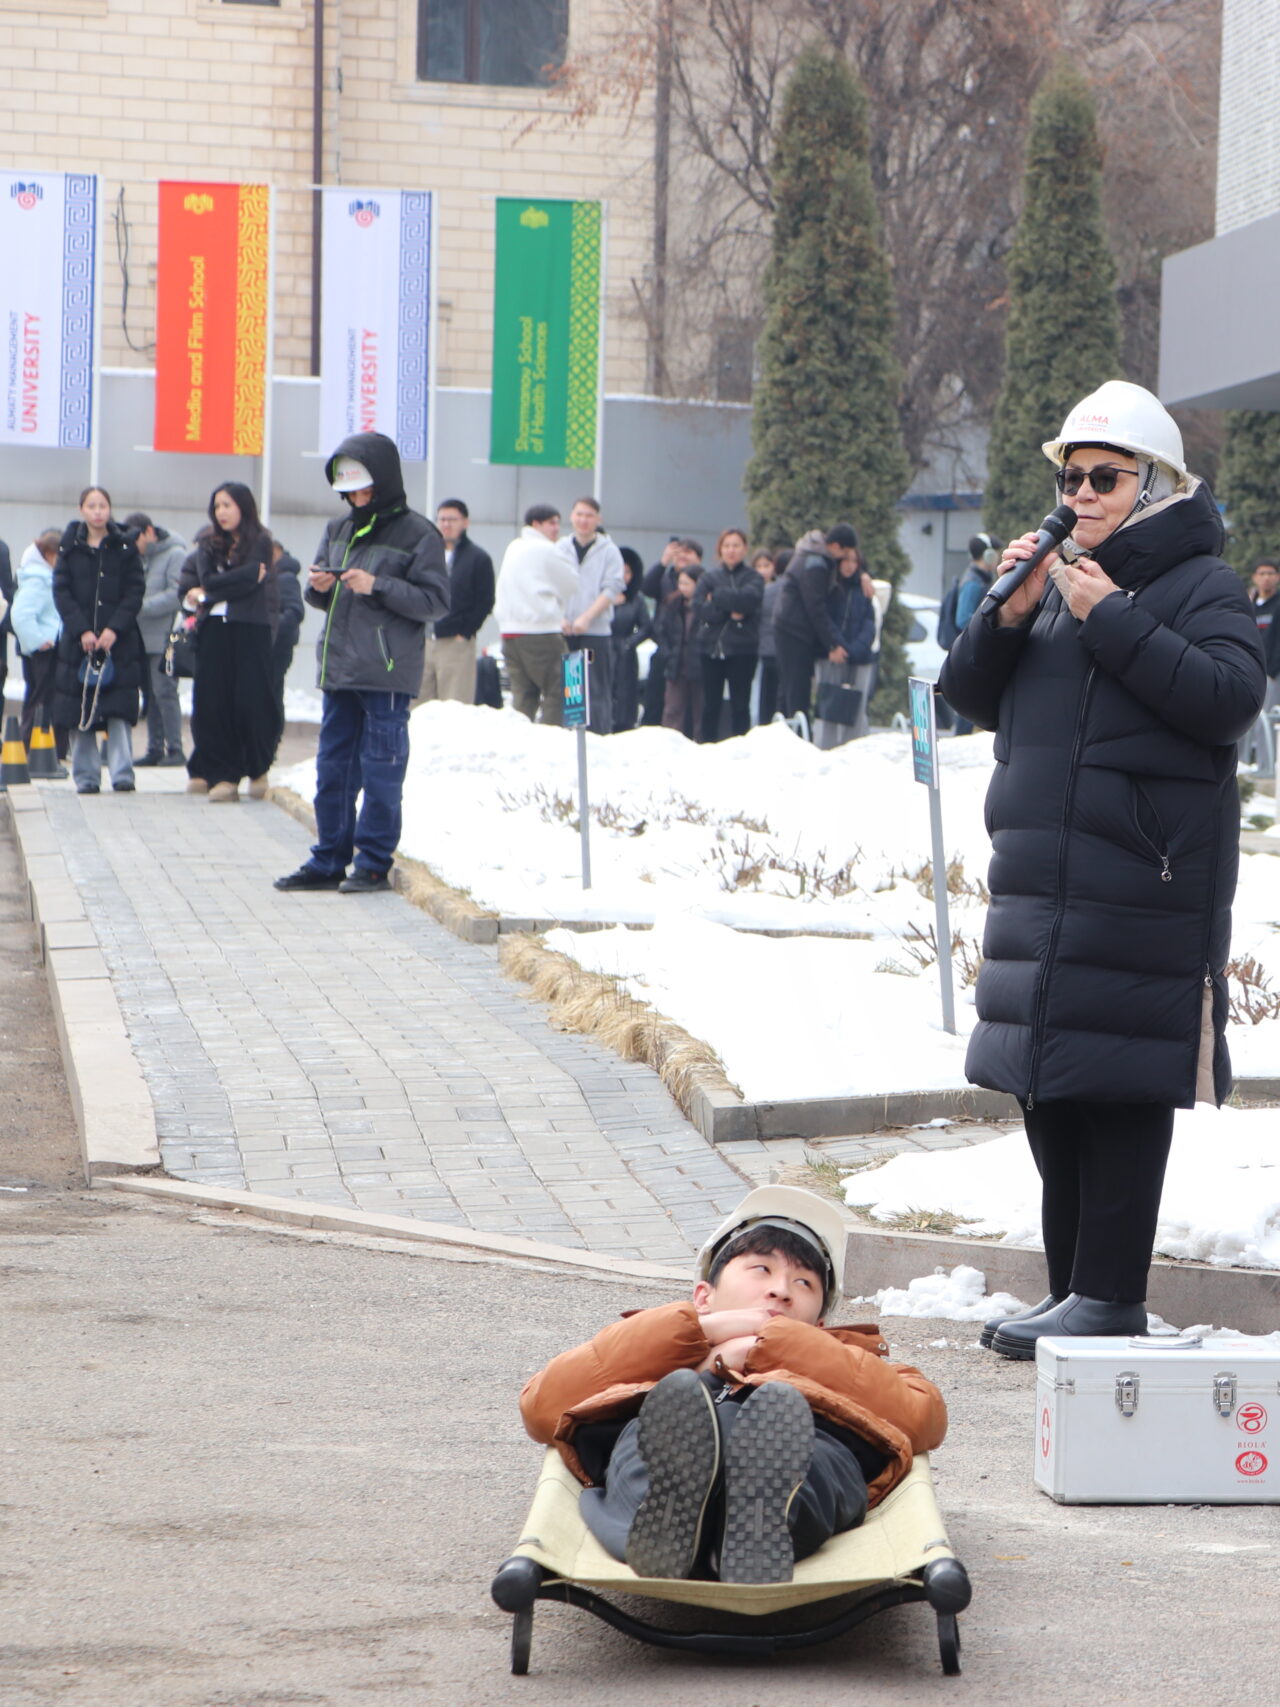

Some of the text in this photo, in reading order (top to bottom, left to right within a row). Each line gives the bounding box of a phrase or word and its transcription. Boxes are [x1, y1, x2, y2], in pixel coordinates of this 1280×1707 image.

[22, 312, 40, 433] UNIVERSITY
[186, 256, 205, 441] Media and Film School
[360, 329, 378, 432] NIVERSITY
[518, 317, 533, 363] School
[531, 321, 548, 453] of Health Sciences
[1080, 415, 1109, 424] ALMA
